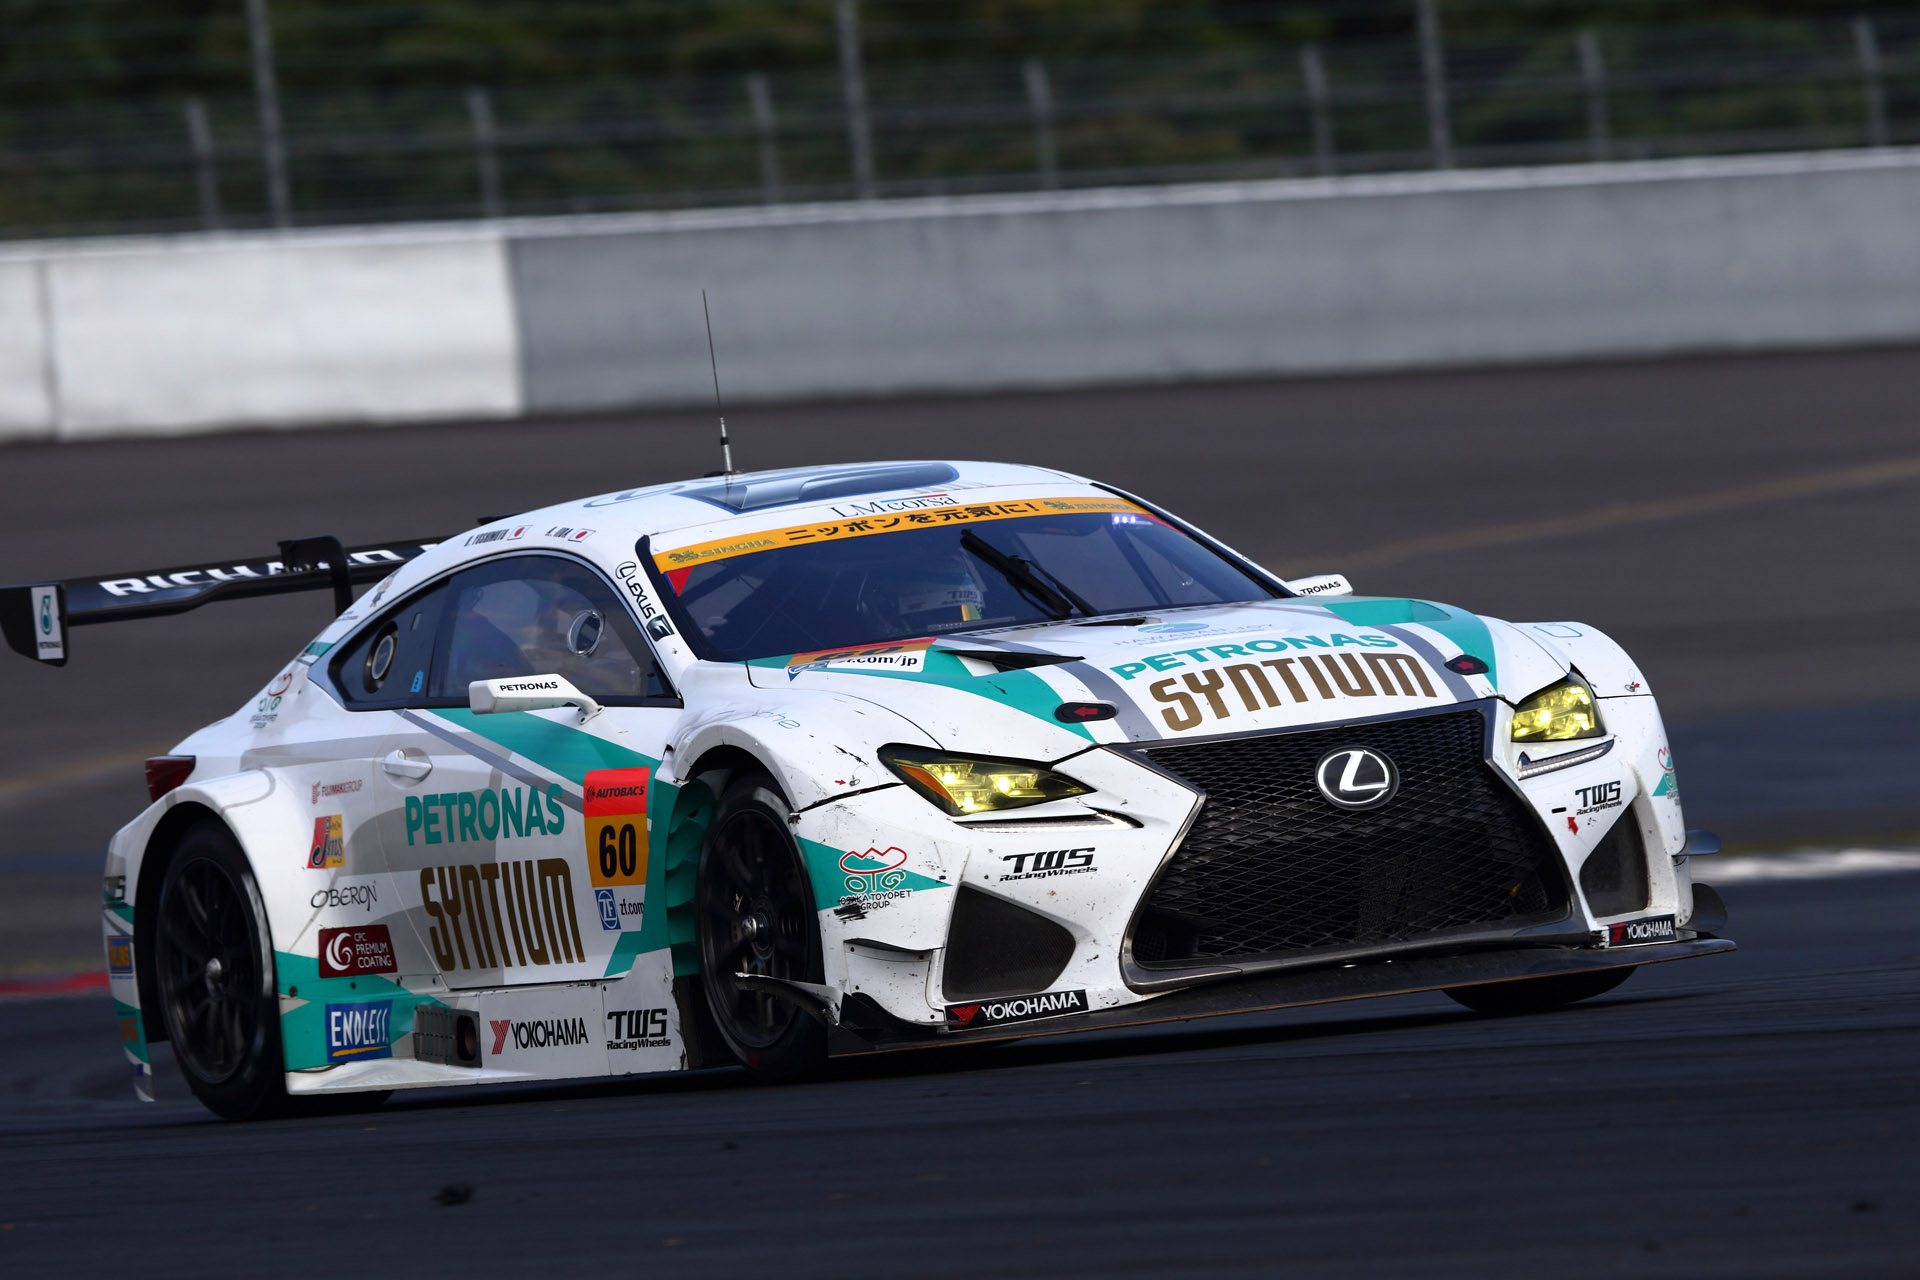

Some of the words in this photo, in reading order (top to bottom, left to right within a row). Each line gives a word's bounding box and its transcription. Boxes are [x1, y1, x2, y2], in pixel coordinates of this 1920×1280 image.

[701, 539, 776, 558] SINGHA
[625, 575, 656, 619] LEXUS
[1299, 580, 1342, 595] TRONAS
[1110, 633, 1399, 681] PETRONAS
[500, 681, 558, 692] PETRONAS
[1149, 652, 1438, 731] SYNTIUM
[596, 786, 645, 798] AUTOBACS
[1575, 780, 1621, 807] TWS
[405, 783, 565, 846] PETRONAS
[599, 823, 636, 878] 60
[1003, 847, 1096, 874] TWS
[310, 881, 377, 912] OBERON
[861, 900, 890, 911] GROUP
[870, 889, 912, 901] TOYOPET
[420, 857, 586, 971] SYNTIUM
[1627, 920, 1674, 939] YOKOHAMA
[355, 942, 389, 955] PREMIUM
[357, 955, 392, 969] COATING
[981, 991, 1081, 1020] YOKOHAMA
[331, 1008, 389, 1046] ENDLESS
[511, 1017, 589, 1049] YOKOHAMA
[607, 1008, 668, 1039] TWS
